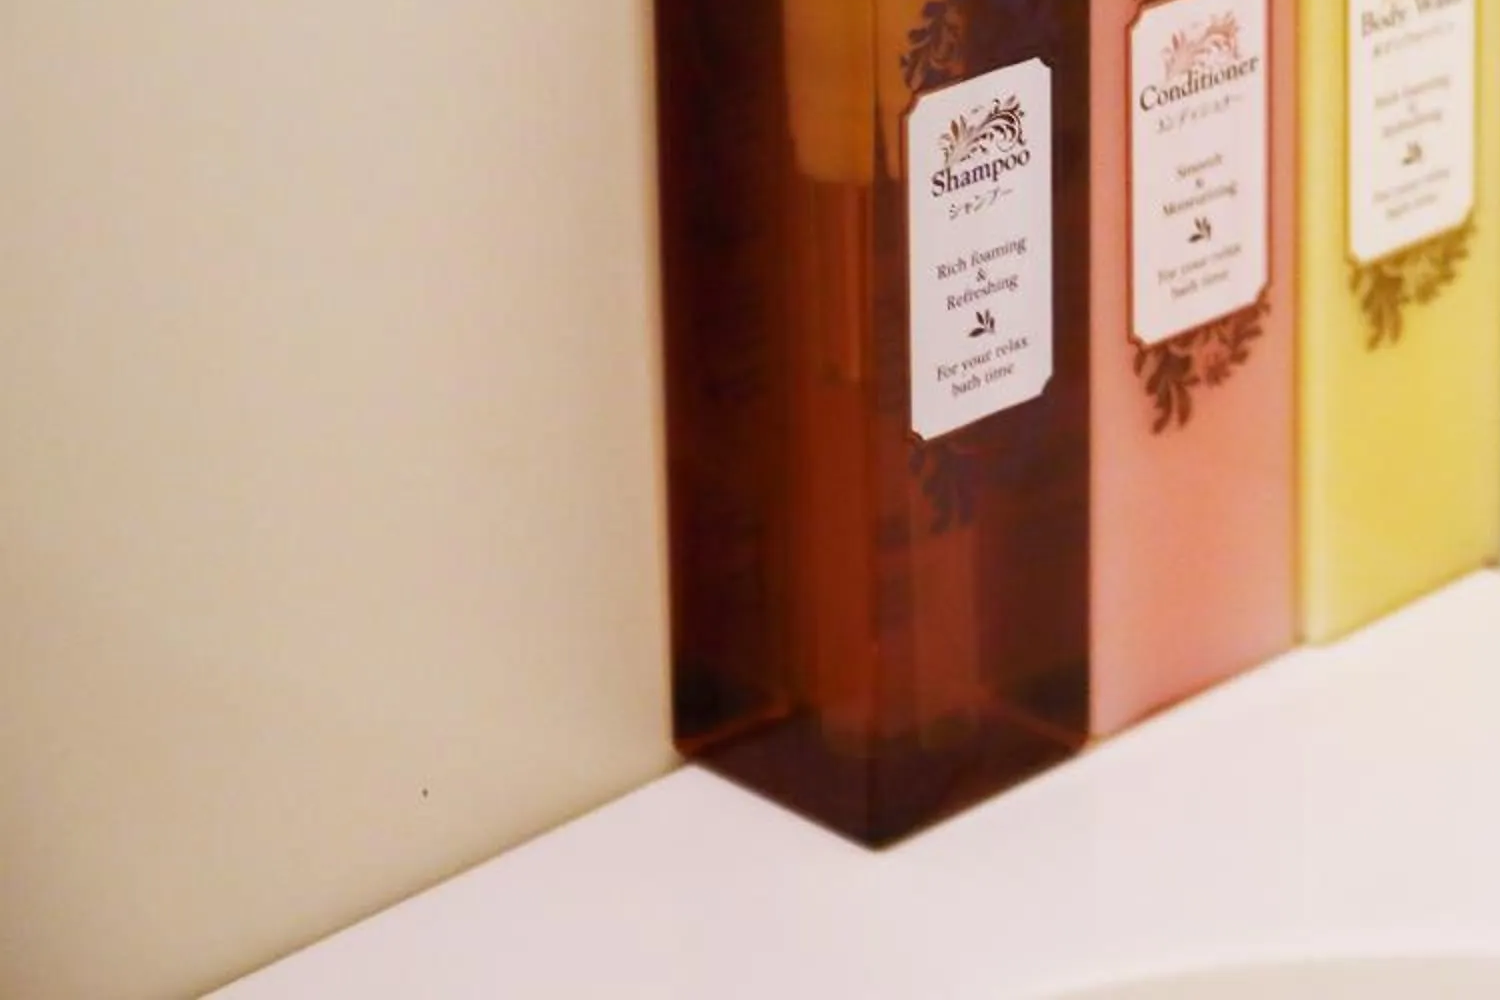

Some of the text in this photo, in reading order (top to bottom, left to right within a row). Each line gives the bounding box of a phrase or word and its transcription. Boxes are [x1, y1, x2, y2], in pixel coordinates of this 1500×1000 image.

[1139, 55, 1259, 112] Conditioner
[931, 148, 1031, 198] Shampoo
[949, 187, 1013, 220] シャンプー
[937, 236, 1027, 281] Rich foaming
[976, 270, 986, 283] &
[946, 274, 1018, 311] Refreshing
[937, 336, 1029, 382] For your relax
